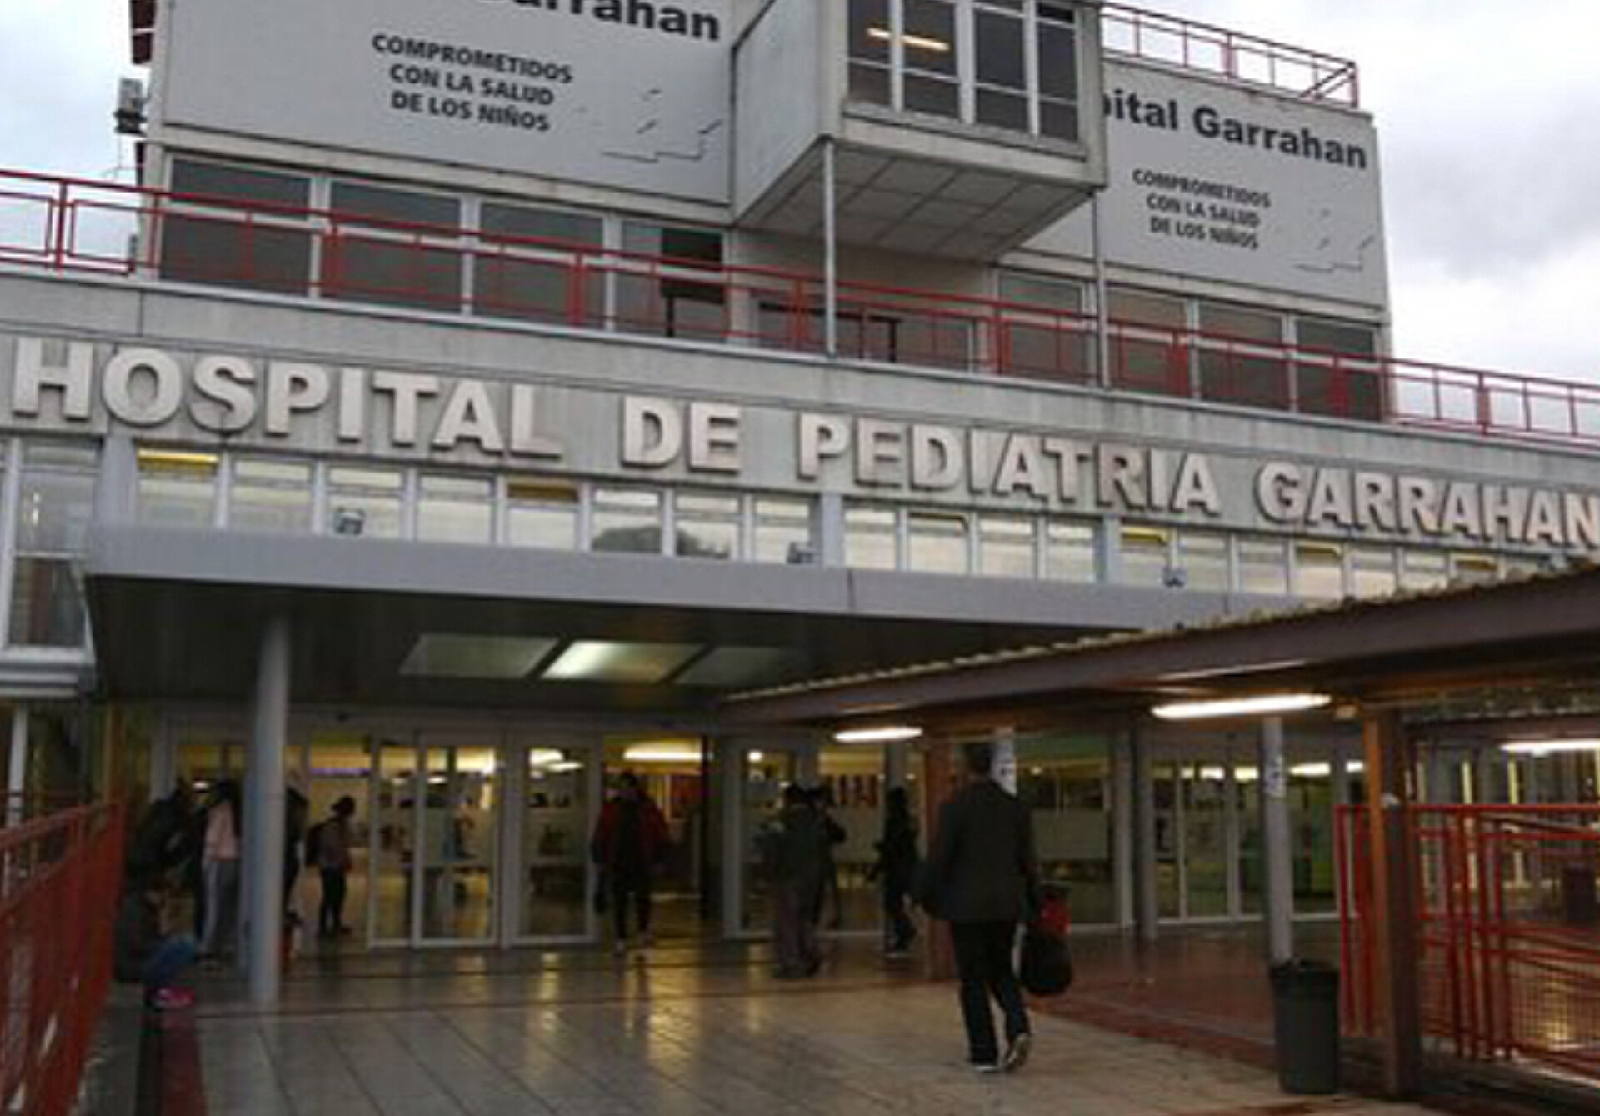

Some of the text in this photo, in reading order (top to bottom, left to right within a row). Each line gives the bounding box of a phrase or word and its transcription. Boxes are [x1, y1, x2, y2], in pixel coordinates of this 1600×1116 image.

[371, 34, 573, 83] COMPROMETIDOS
[390, 63, 554, 105] CON LA SALUD
[391, 90, 550, 131] DE LOS NIÑOS
[1192, 104, 1367, 169] Garrahan
[1146, 192, 1260, 228] CON LA SALUD
[1150, 216, 1170, 235] DE
[1176, 220, 1206, 239] LOS
[12, 337, 1600, 550] HOSPITAL DE PEDIATRIA GARRAHAN
